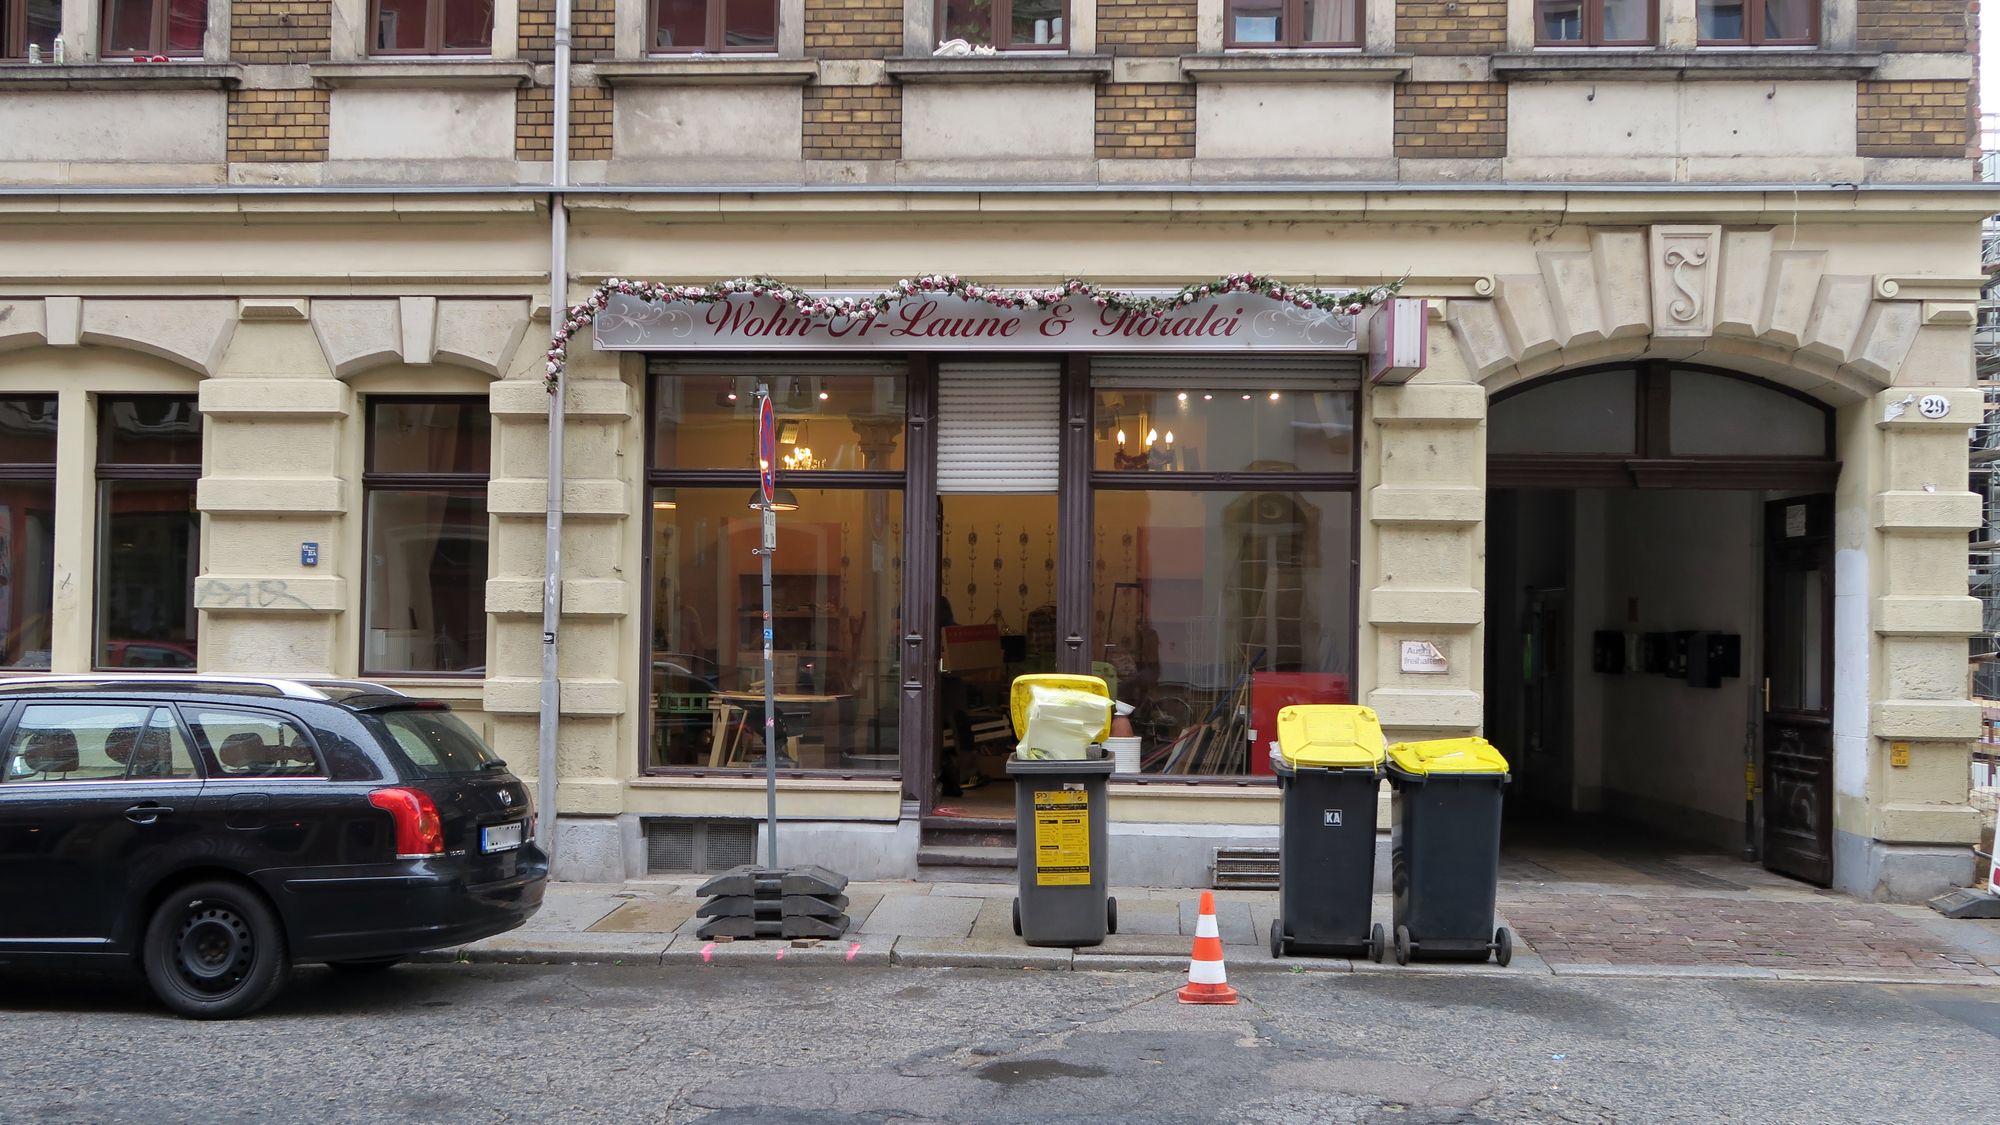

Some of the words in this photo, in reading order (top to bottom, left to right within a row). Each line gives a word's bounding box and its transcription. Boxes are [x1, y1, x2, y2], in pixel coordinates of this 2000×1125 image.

[1039, 304, 1075, 337] &
[1092, 303, 1243, 337] Floralei
[1924, 398, 1945, 414] 29
[1326, 812, 1340, 823] KA
